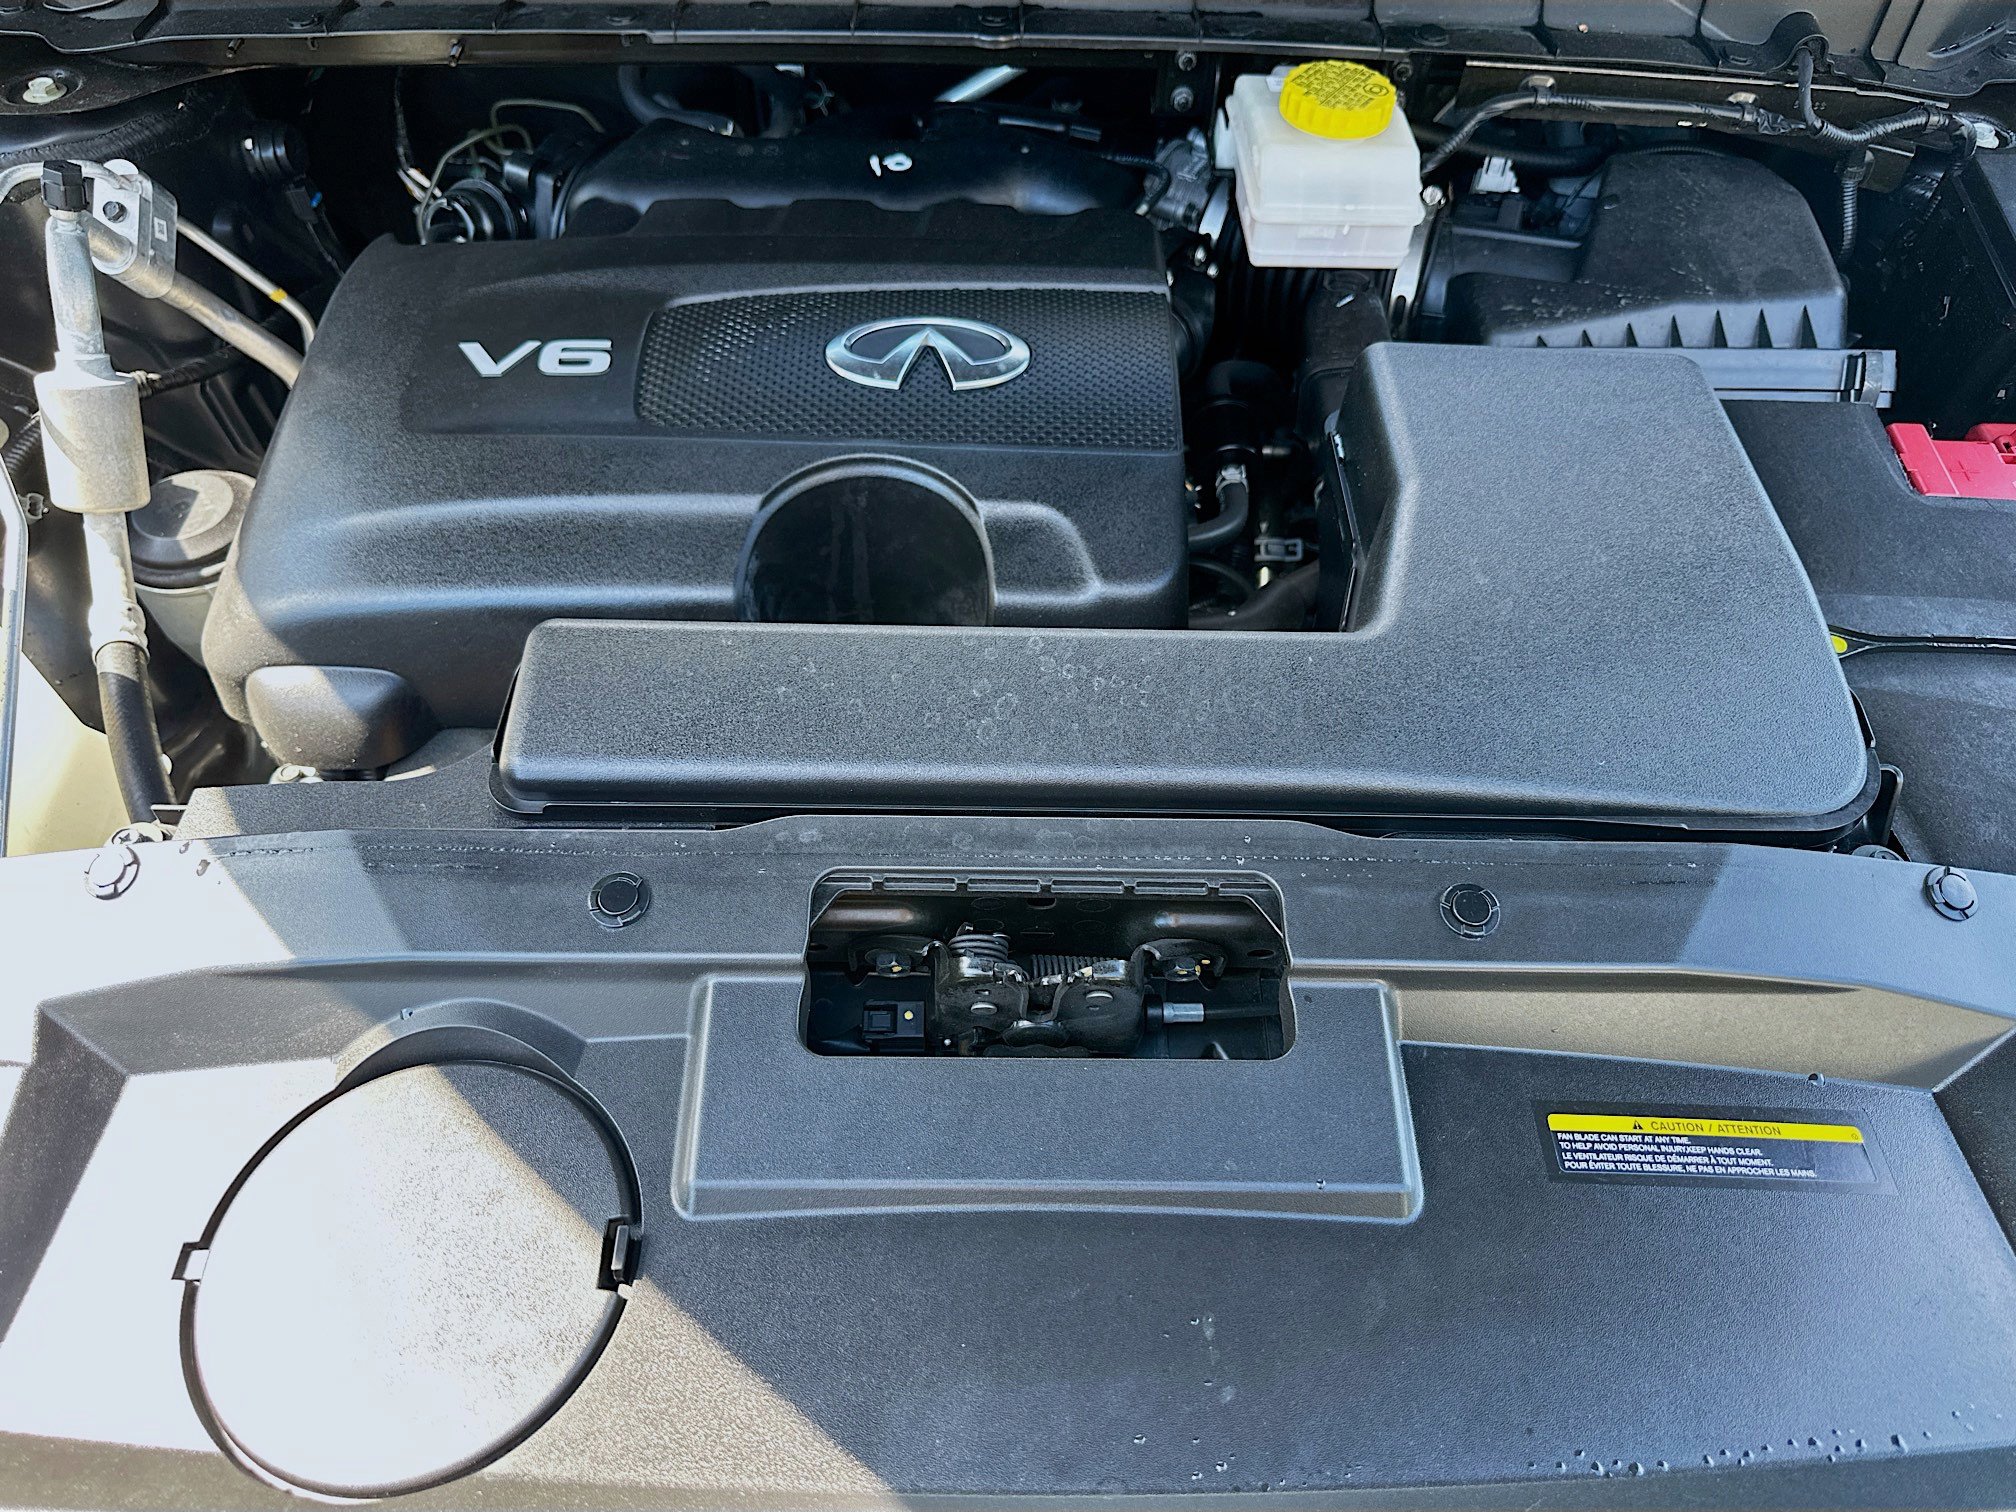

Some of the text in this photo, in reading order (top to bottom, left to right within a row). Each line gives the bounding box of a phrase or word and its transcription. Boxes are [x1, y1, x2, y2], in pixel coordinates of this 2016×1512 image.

[458, 339, 612, 377] V6
[1651, 1121, 1704, 1132] CAUTION
[1717, 1124, 1781, 1136] ATTENTION
[1557, 1132, 1691, 1144] FAN BLADE CAN START AT ANY TIME.
[1559, 1141, 1571, 1150] TO
[1572, 1142, 1593, 1150] HELP
[1594, 1143, 1618, 1151] AVOID
[1618, 1143, 1660, 1152] PERSONAL
[1707, 1146, 1735, 1154] HANDS
[1736, 1147, 1763, 1156] CLEAR.
[1562, 1152, 1573, 1160] LE
[1573, 1152, 1624, 1161] VENTILATEUR
[1624, 1154, 1654, 1162] RISQUE
[1667, 1153, 1710, 1164] DÉMARRER
[1716, 1156, 1738, 1165] TOUT
[1738, 1158, 1774, 1167] MOMENT.
[1564, 1160, 1817, 1178] POUR ÉVITER TOUTE BLESSURE, NE PAS EN APPROCHER LES MAINS.
